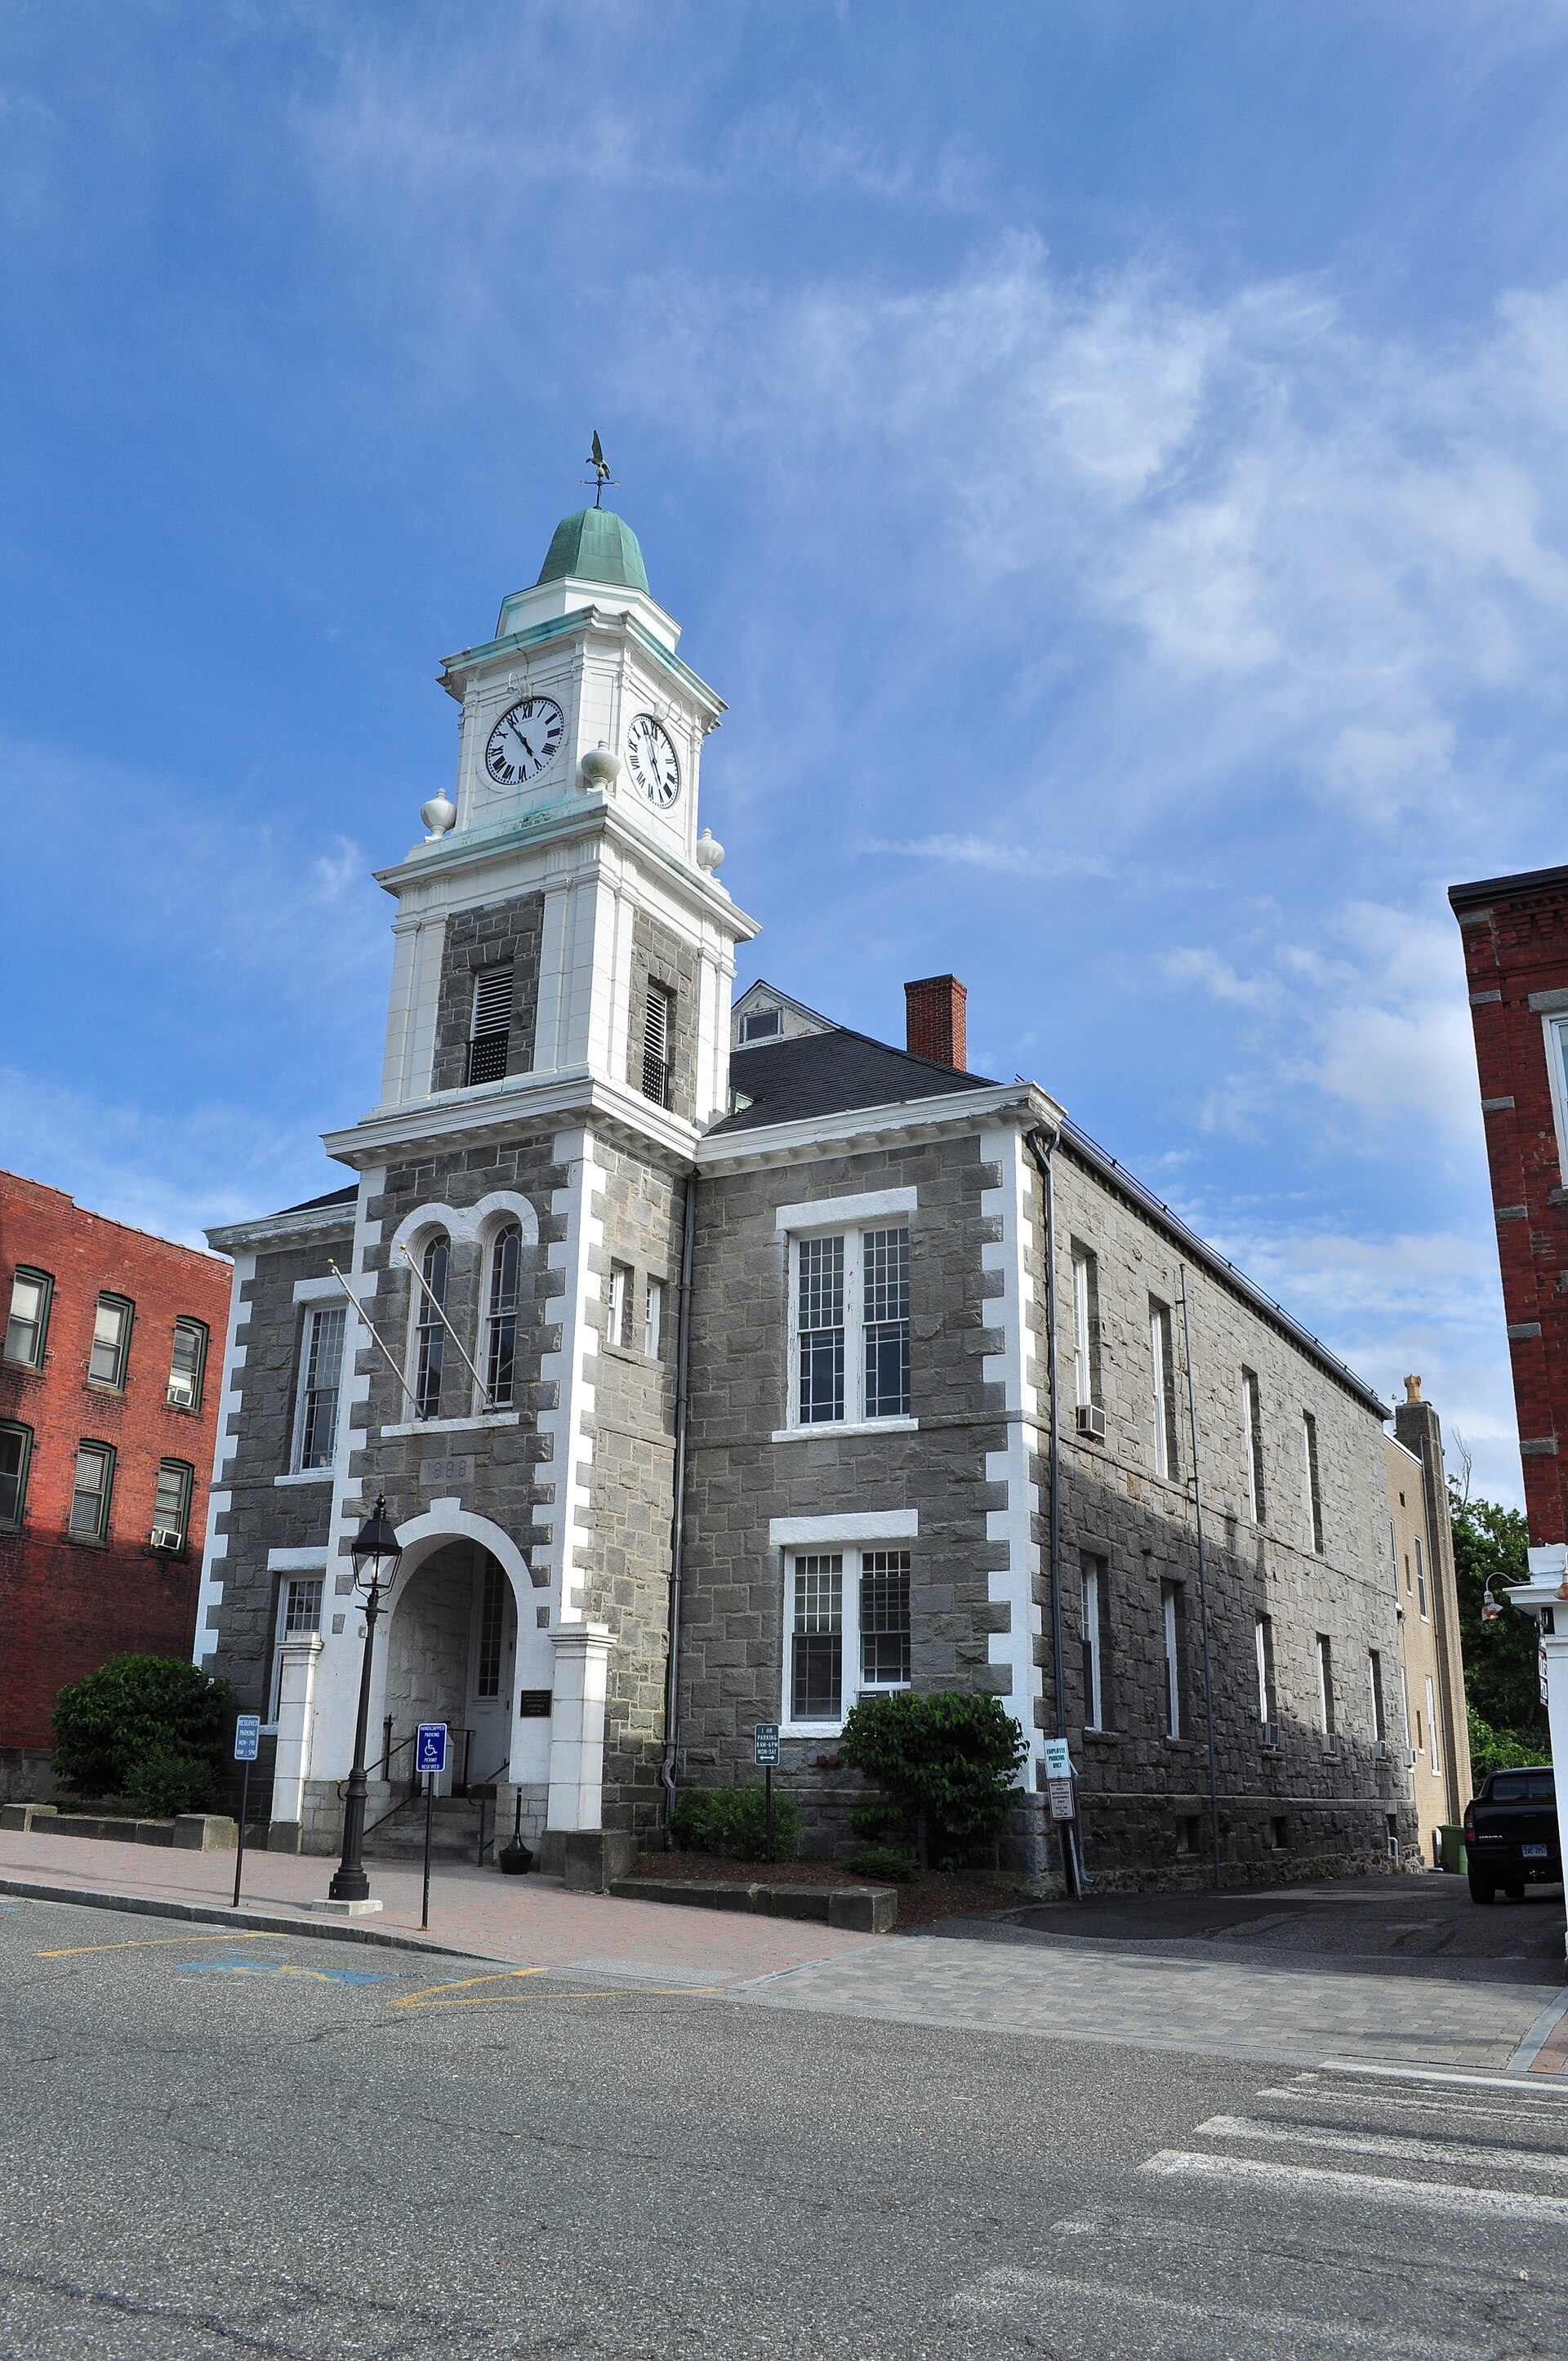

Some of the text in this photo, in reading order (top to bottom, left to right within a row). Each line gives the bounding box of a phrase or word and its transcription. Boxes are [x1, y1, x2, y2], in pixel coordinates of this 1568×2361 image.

[537, 702, 546, 718] I
[547, 728, 560, 738] III
[491, 745, 504, 757] IX
[541, 742, 556, 755] IIII
[534, 758, 542, 769] V
[630, 755, 640, 770] VIII
[519, 764, 527, 779] VI
[427, 1460, 466, 1478] 1888
